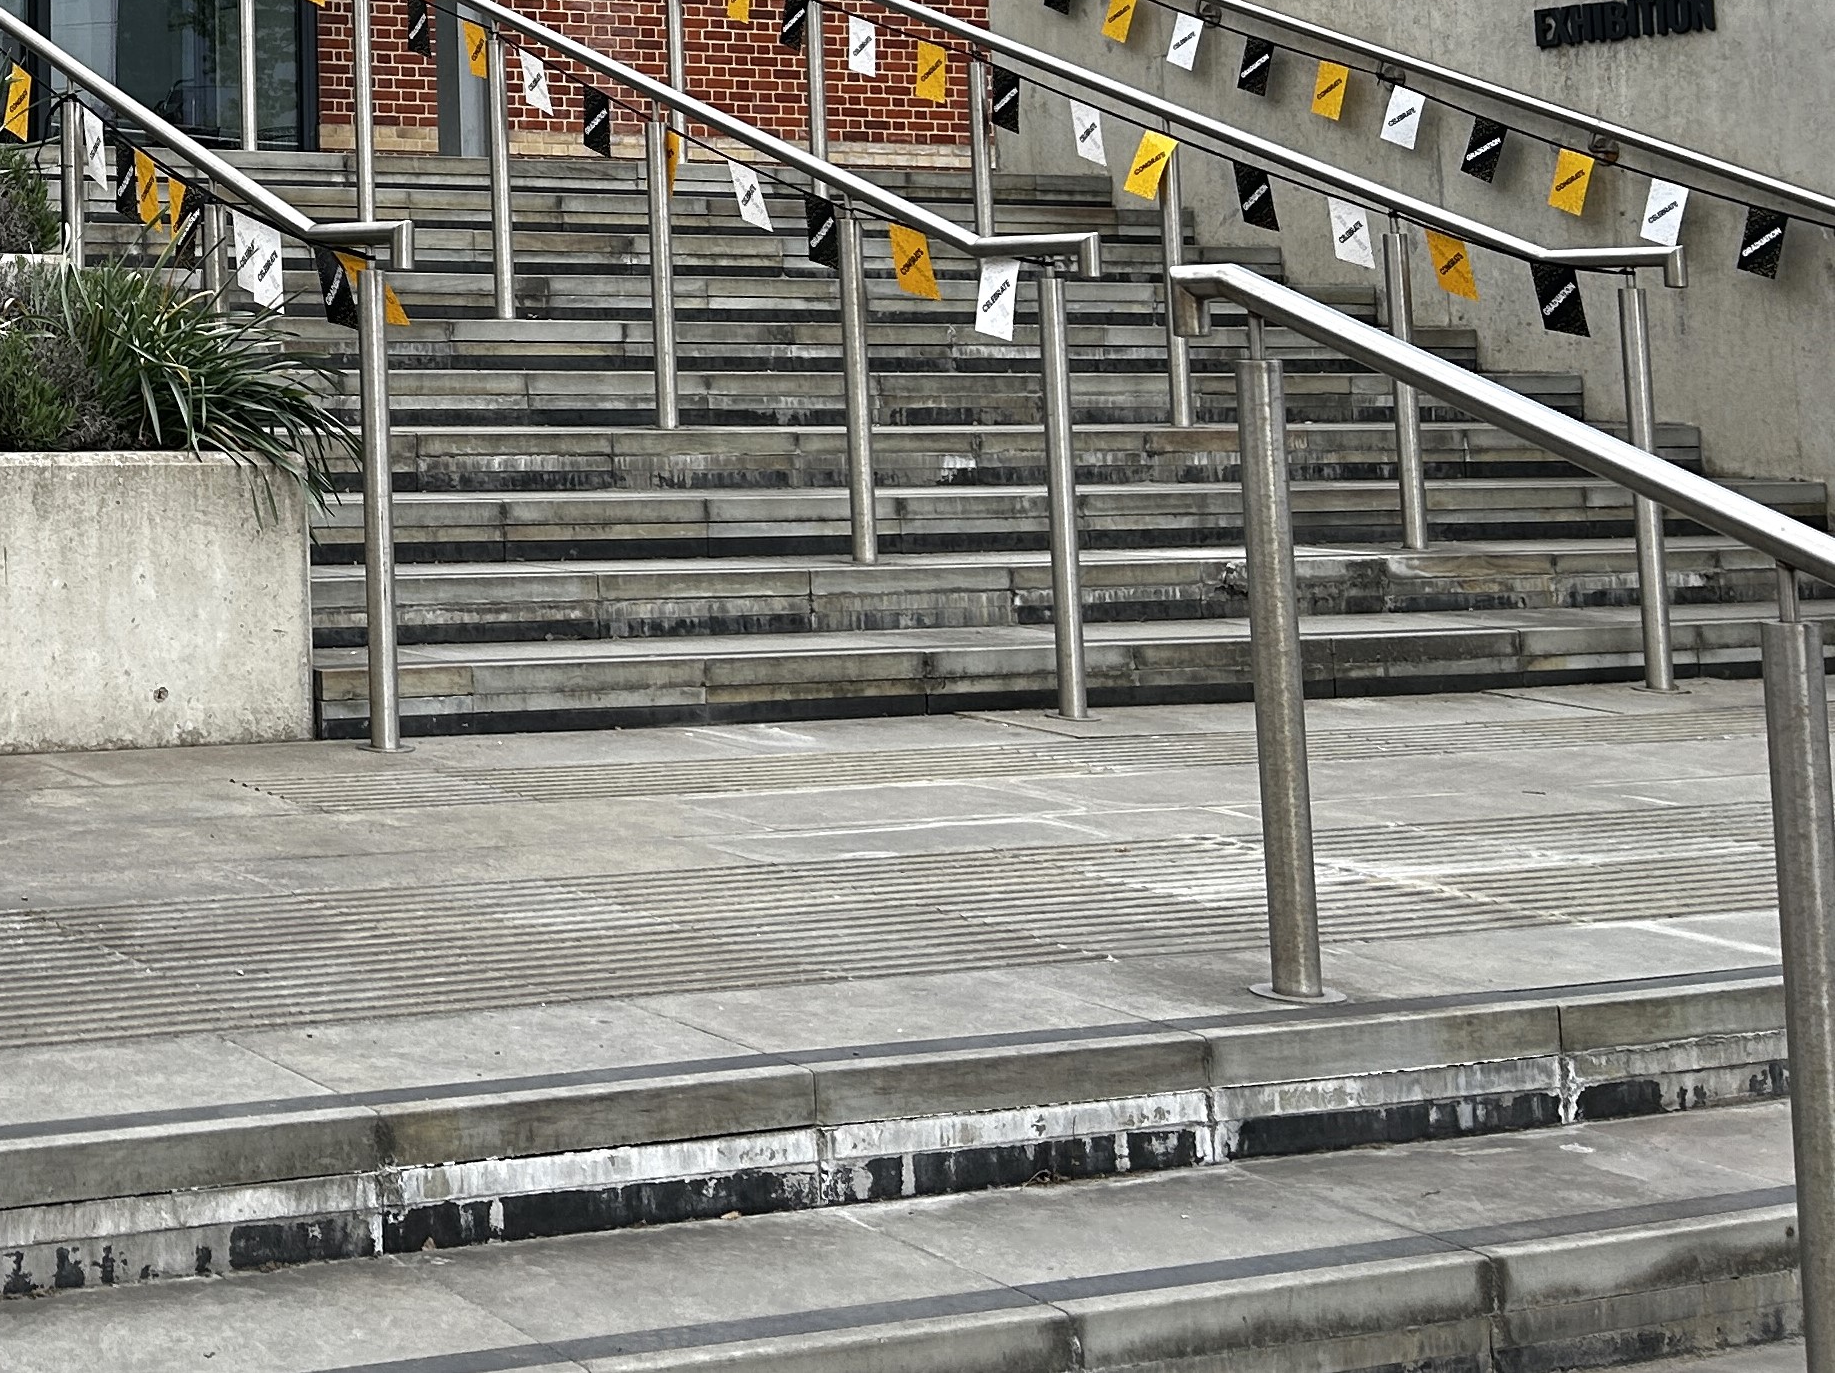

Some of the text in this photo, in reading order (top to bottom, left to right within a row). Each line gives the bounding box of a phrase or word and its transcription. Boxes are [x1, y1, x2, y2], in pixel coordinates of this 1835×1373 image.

[1741, 226, 1781, 258] GRADUATION
[982, 279, 1011, 312] CELEBRATE
[1542, 281, 1576, 316] GRADUATION
